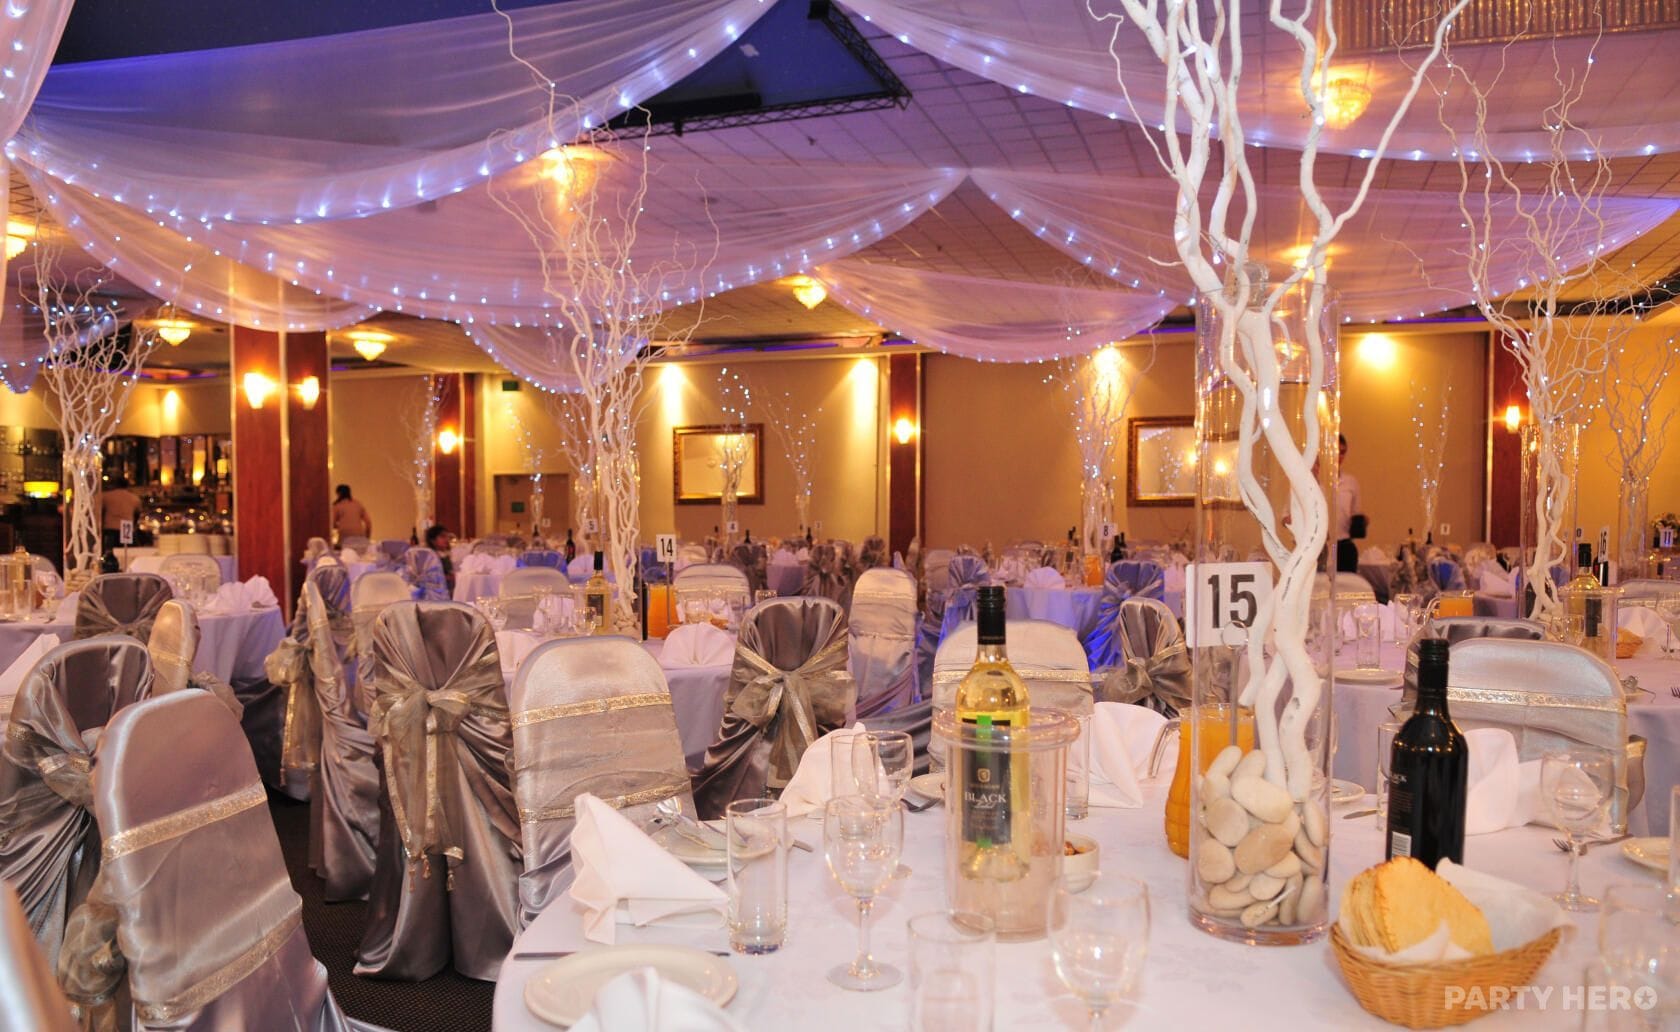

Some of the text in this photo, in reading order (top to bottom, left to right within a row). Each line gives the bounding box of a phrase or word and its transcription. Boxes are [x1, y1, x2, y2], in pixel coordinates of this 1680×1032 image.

[122, 522, 131, 540] 12
[660, 538, 673, 557] 14
[1207, 574, 1258, 629] 15
[964, 791, 1007, 803] BLACK
